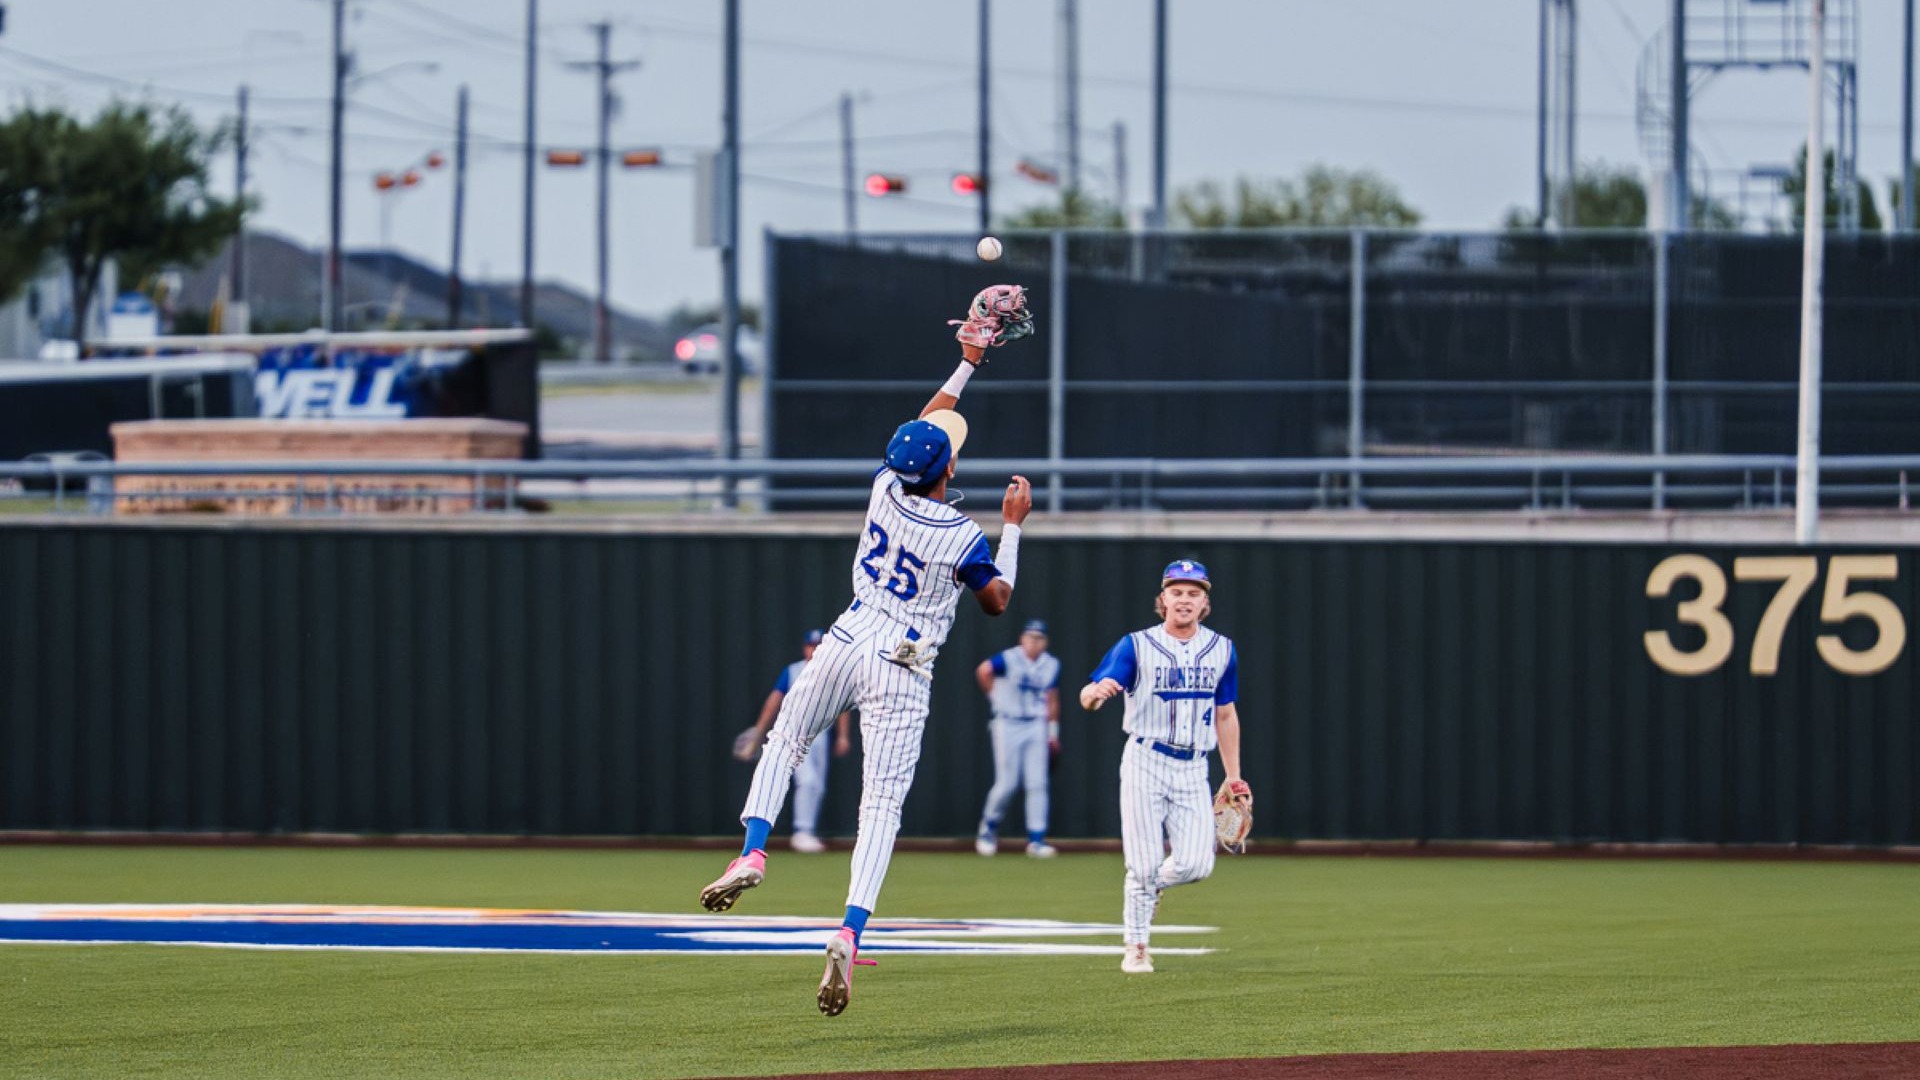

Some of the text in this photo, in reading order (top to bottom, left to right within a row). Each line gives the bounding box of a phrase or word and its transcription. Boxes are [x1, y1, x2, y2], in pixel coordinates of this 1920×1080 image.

[860, 520, 925, 601] 25
[1644, 553, 1906, 676] 375
[1154, 666, 1216, 689] PIONEERS
[1202, 707, 1212, 726] 4
